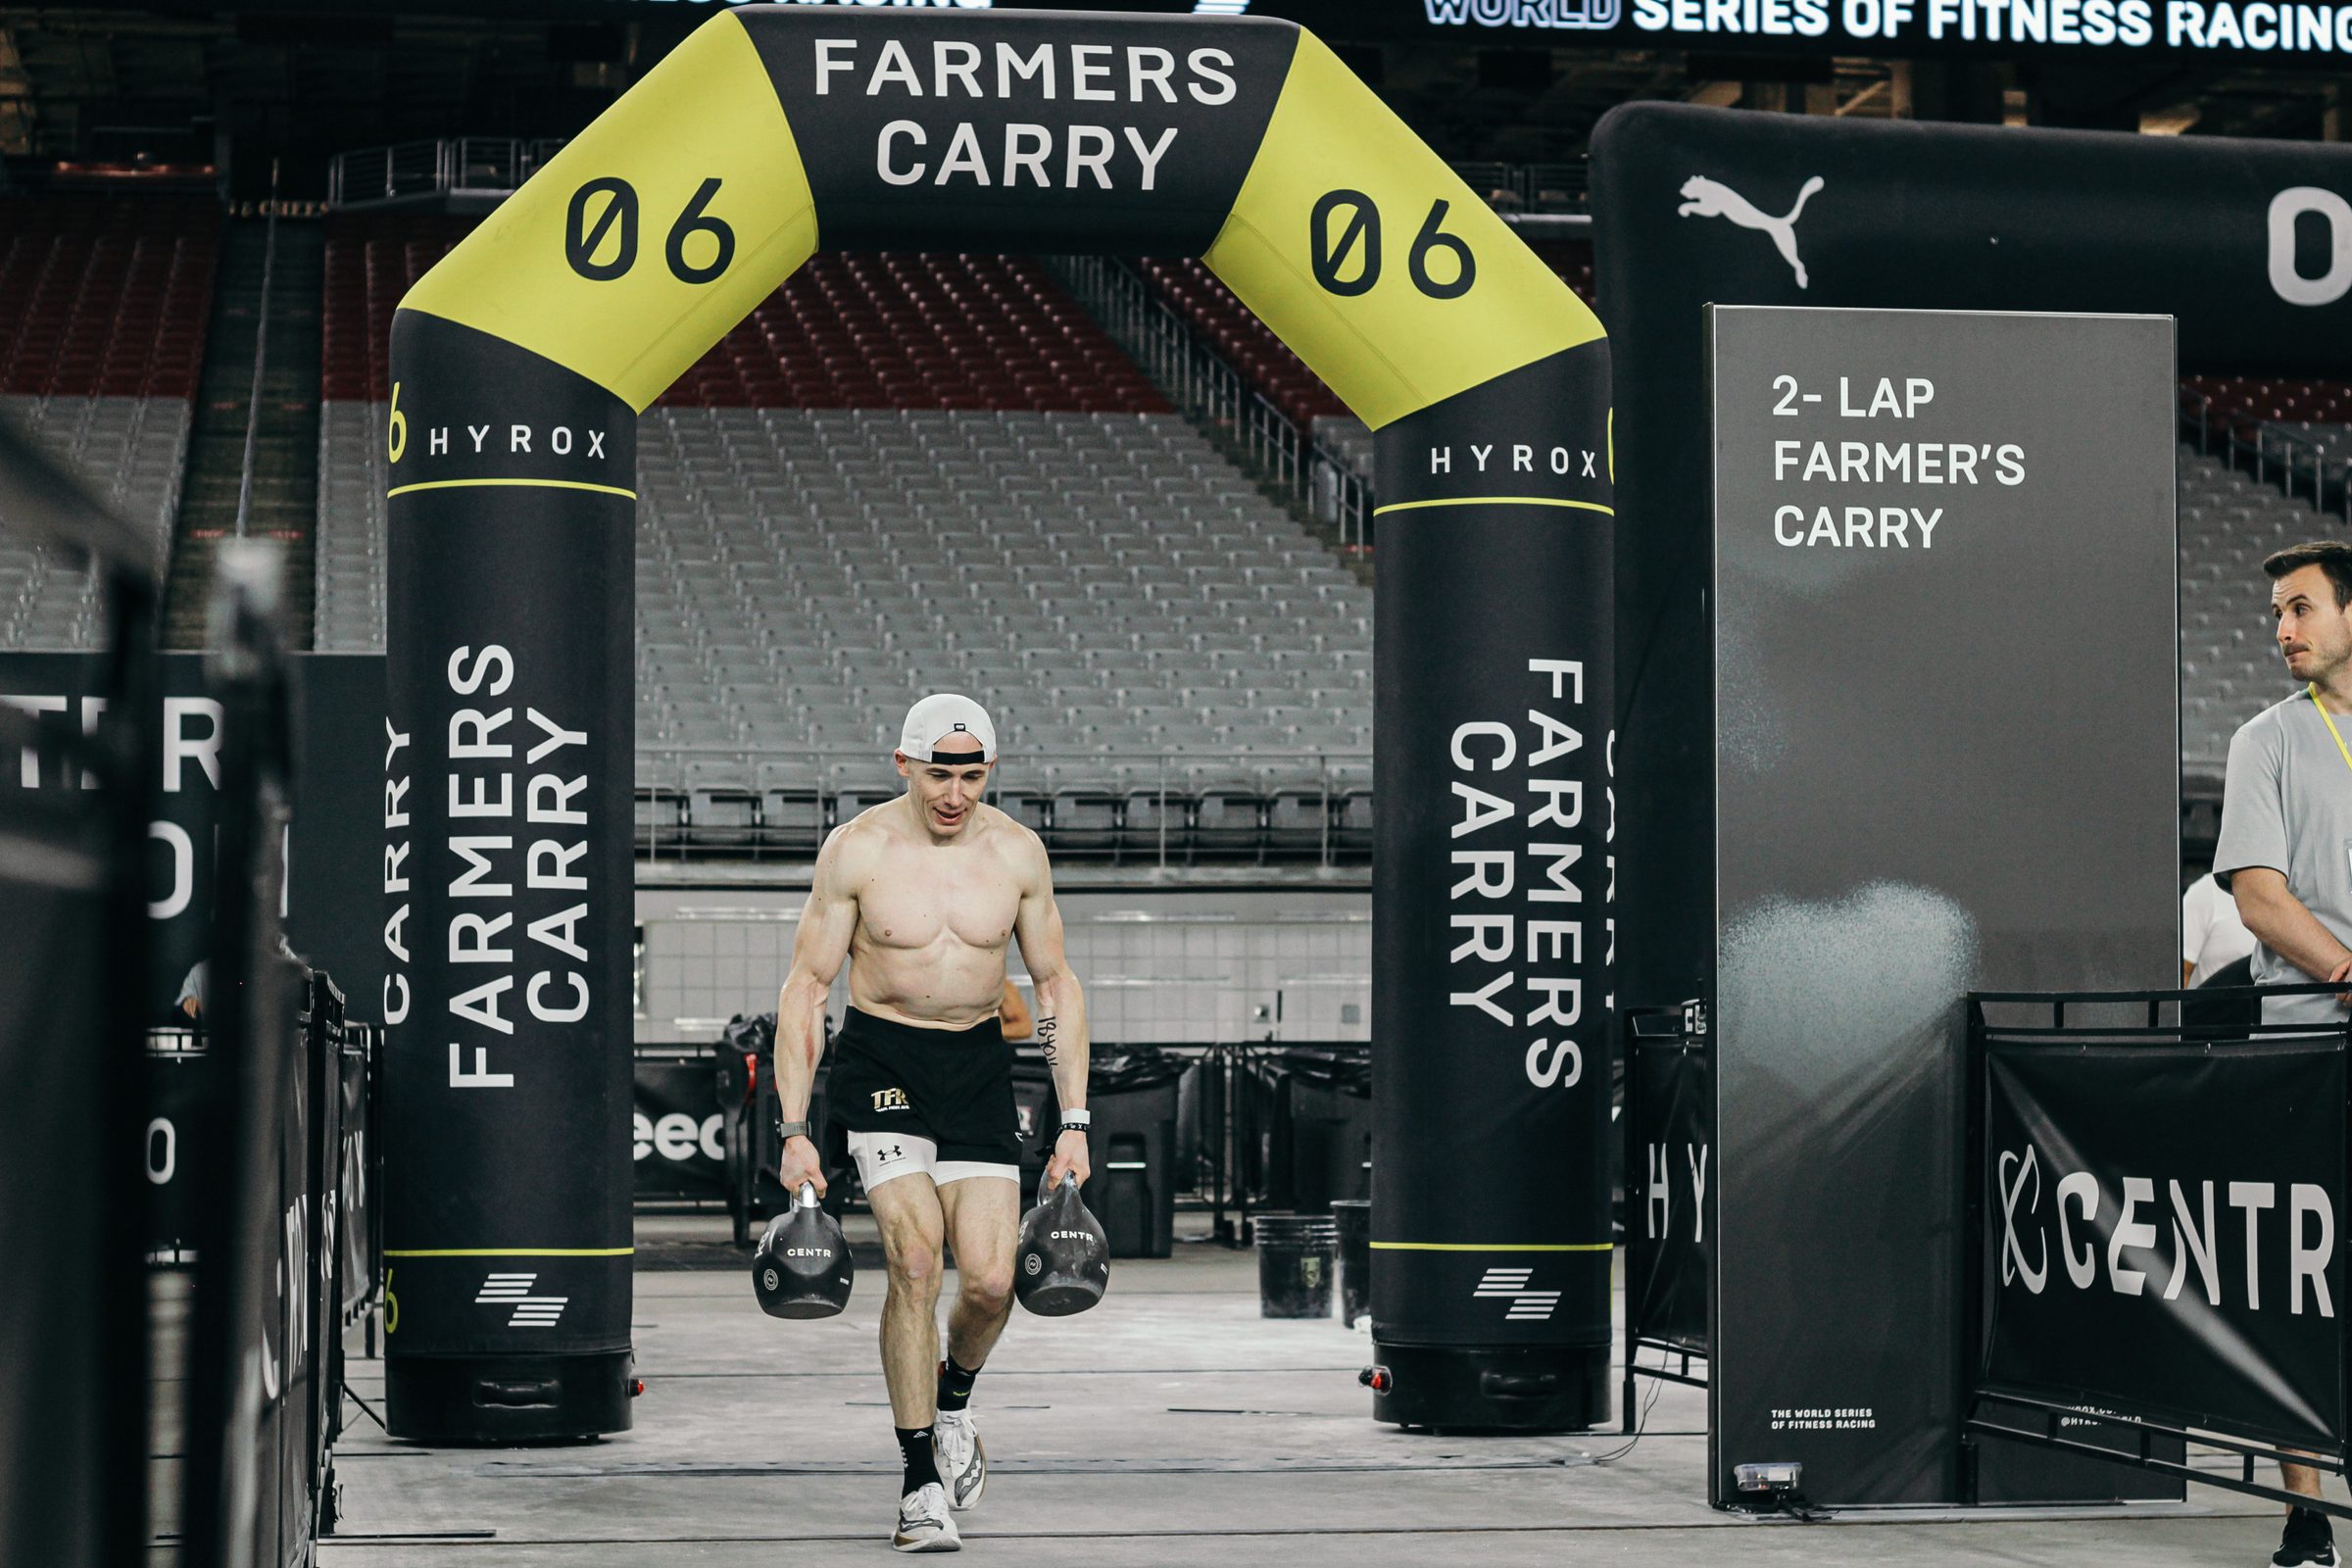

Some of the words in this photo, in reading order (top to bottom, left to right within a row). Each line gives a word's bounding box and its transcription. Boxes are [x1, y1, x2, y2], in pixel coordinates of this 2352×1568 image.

[1423, 0, 1622, 30] WORLD
[1632, 0, 1830, 37] SERIES
[1842, 0, 1916, 38] OF
[1928, 0, 2153, 46] FITNESS
[813, 38, 1238, 106] FARMERS
[876, 119, 1179, 191] CARRY
[564, 176, 736, 285] 06
[1309, 188, 1477, 300] 06
[1839, 376, 1935, 418] LAP
[429, 424, 605, 460] HYROX
[1431, 444, 1596, 479] HYROX
[1774, 505, 1943, 549] CARRY
[384, 715, 411, 1025] CARRY
[447, 644, 514, 1088] FARMERS
[525, 707, 590, 1023] CARRY
[1449, 720, 1517, 1027] CARRY
[1525, 658, 1584, 1089] FARMERS
[871, 1088, 908, 1109] TFR
[1647, 1142, 1708, 1244] HY
[787, 1248, 832, 1258] CENTR
[1050, 1230, 1094, 1243] CENTR
[2056, 1171, 2334, 1318] CENTR
[1770, 1409, 1791, 1419] THE
[1794, 1409, 1832, 1419] WORLD
[1834, 1408, 1873, 1418] SERIES
[1771, 1421, 1786, 1430] OF
[1788, 1420, 1833, 1430] FITNESS
[1836, 1419, 1876, 1429] RACING
